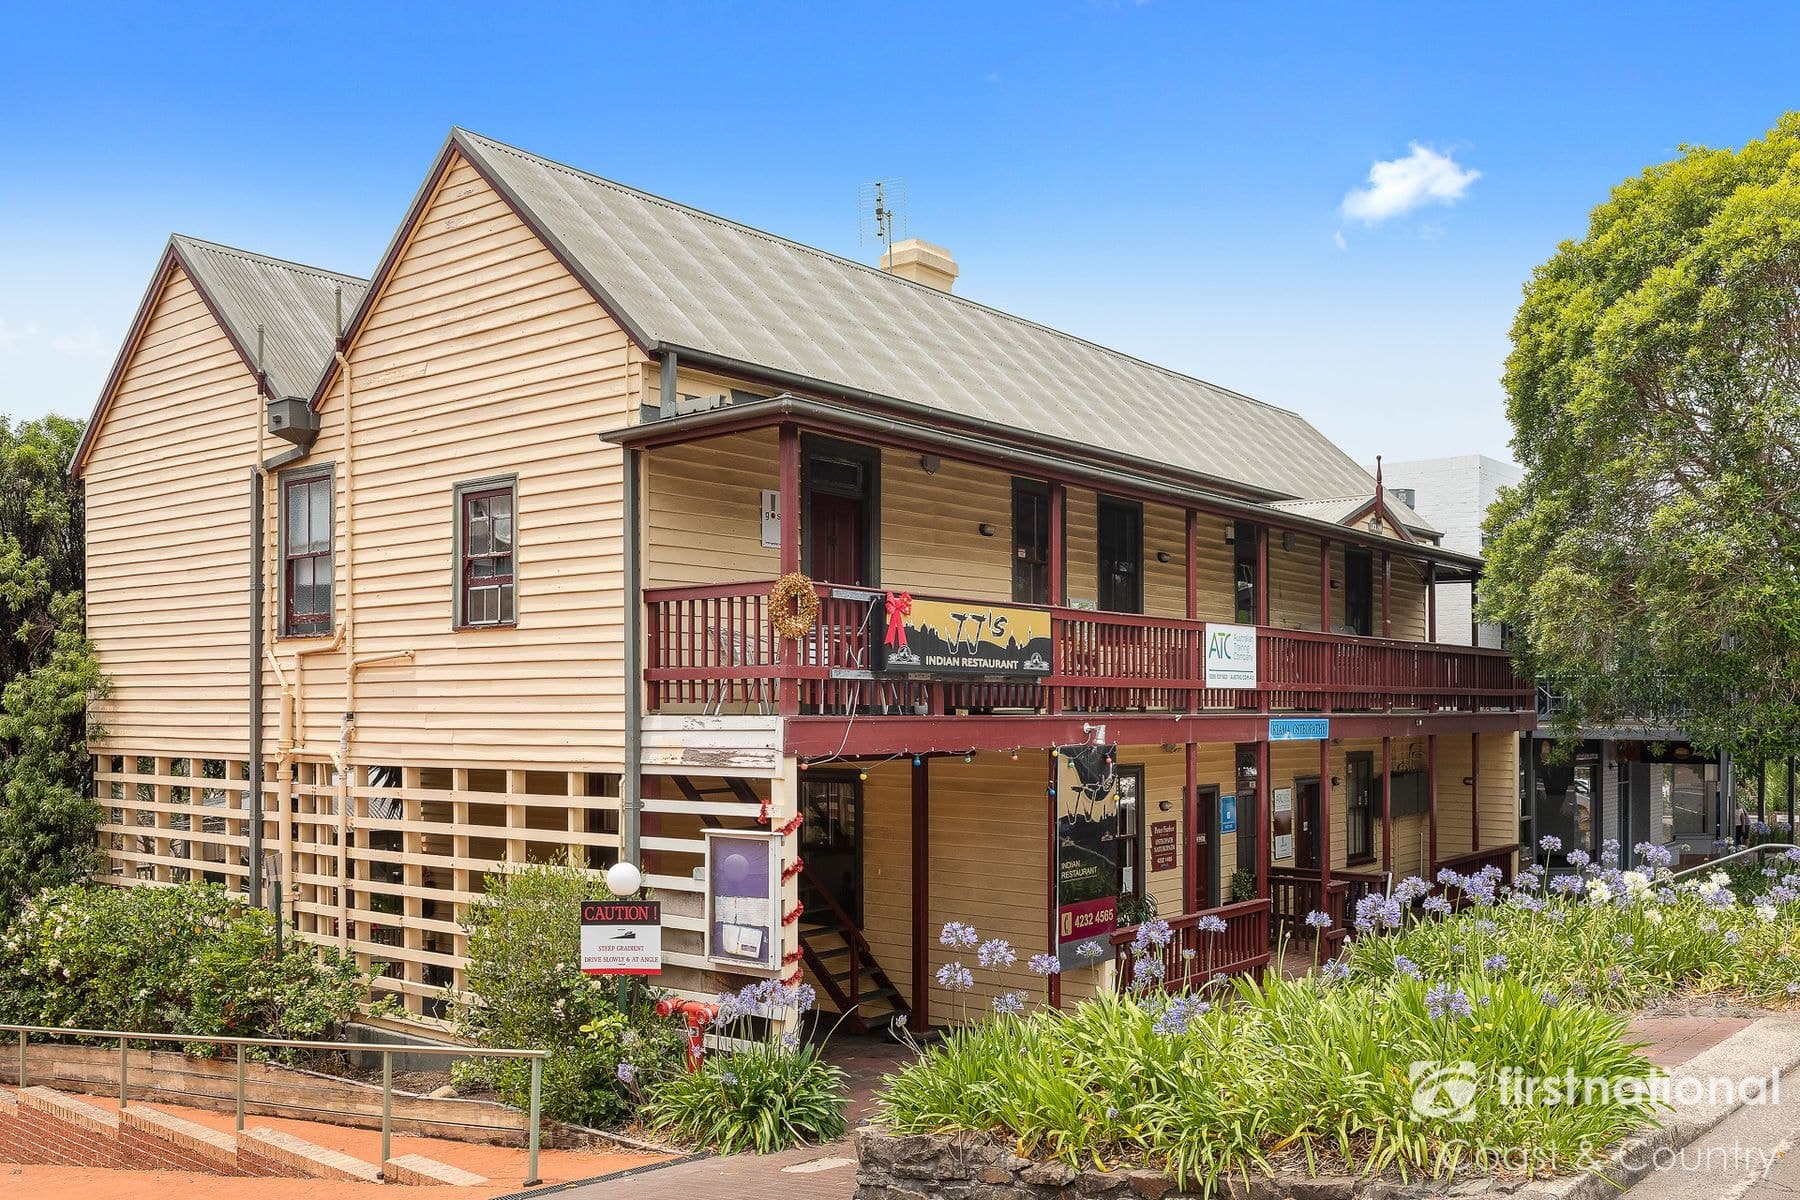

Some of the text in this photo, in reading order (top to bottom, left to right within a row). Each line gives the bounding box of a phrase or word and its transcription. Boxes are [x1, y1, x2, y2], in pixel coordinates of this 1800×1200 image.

[1208, 631, 1231, 660] ATC
[925, 655, 1019, 670] INDIAN RESTAURANT
[1061, 860, 1080, 870] INDIAN
[1061, 865, 1097, 879] RESTAURANT
[584, 906, 649, 921] CAUTION
[1074, 908, 1114, 928] 4232 4565
